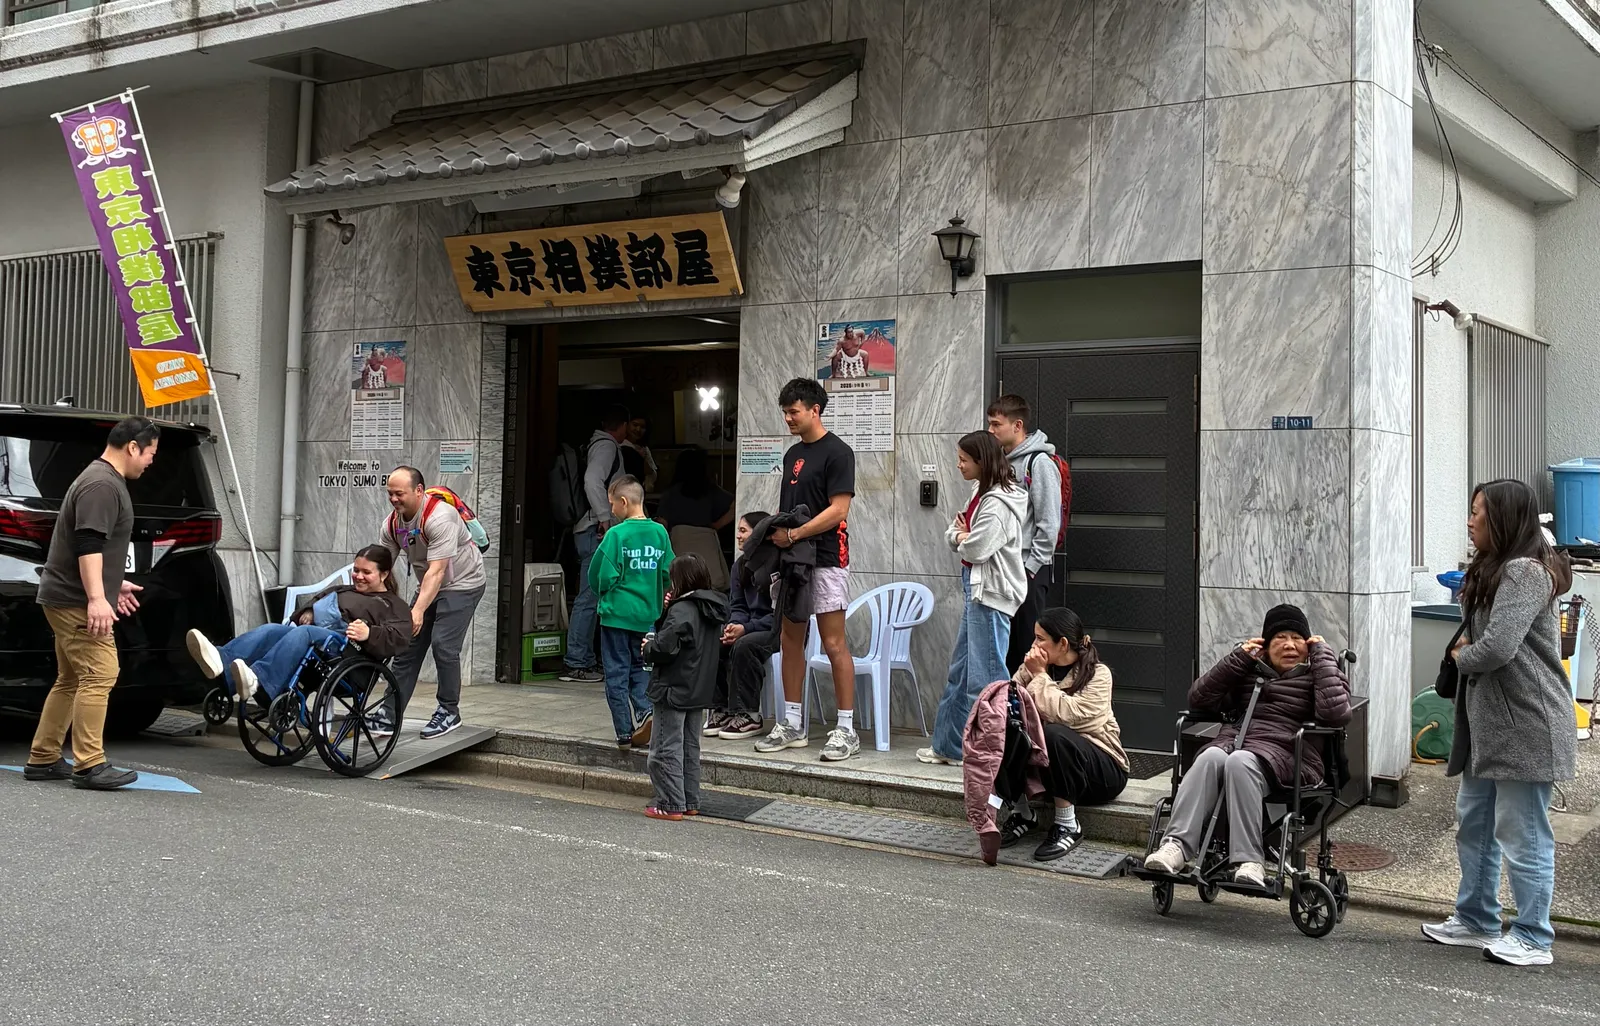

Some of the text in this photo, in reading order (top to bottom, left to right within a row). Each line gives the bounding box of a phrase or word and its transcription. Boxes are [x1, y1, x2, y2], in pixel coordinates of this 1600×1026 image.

[464, 228, 720, 299] 東京相撲部屋
[1290, 418, 1310, 427] 10-11
[338, 461, 380, 471] Welcome to
[319, 475, 347, 487] TOKYO
[353, 475, 377, 487] SUMO
[621, 546, 642, 558] Fun
[629, 558, 658, 570] Club
